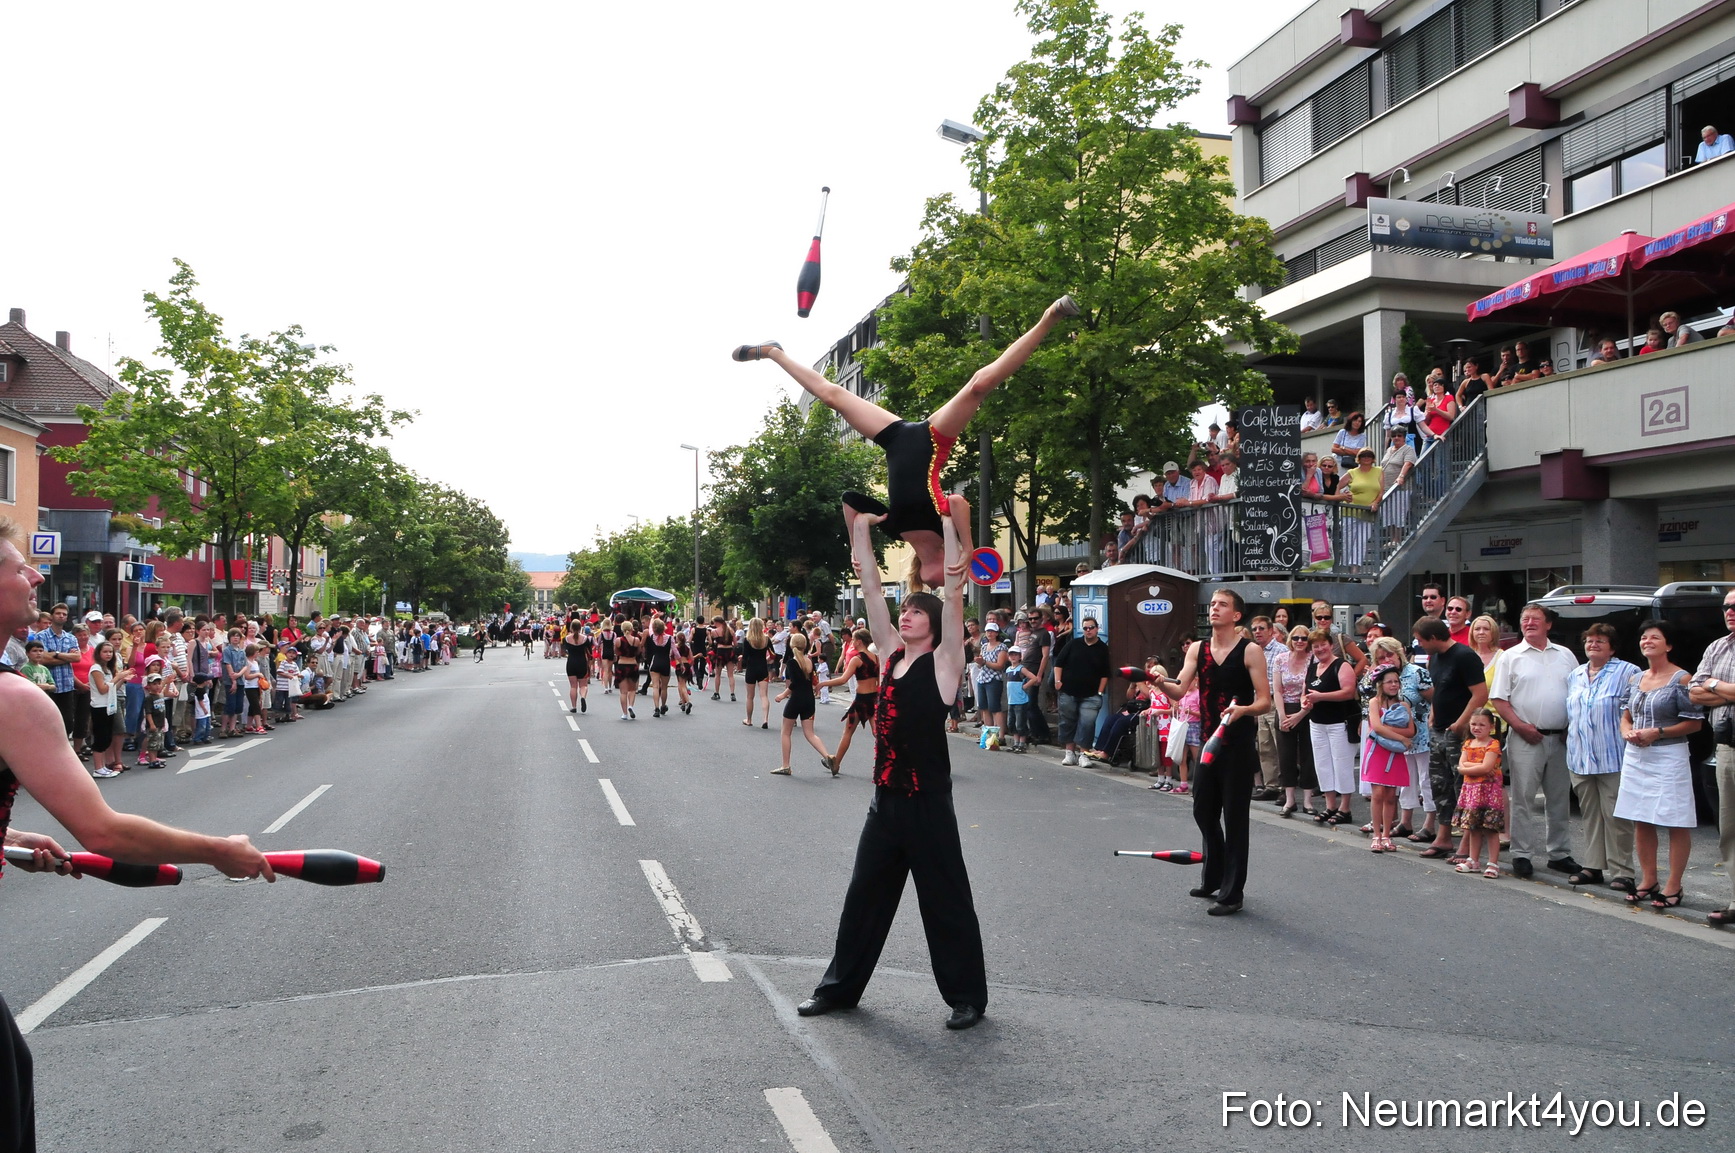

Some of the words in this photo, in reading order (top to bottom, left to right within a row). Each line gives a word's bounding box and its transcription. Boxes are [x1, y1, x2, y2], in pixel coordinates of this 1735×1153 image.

[1644, 231, 1686, 257] Winkler
[1687, 220, 1713, 240] Bräu
[1553, 266, 1587, 285] Winkler
[1648, 398, 1682, 427] 2a
